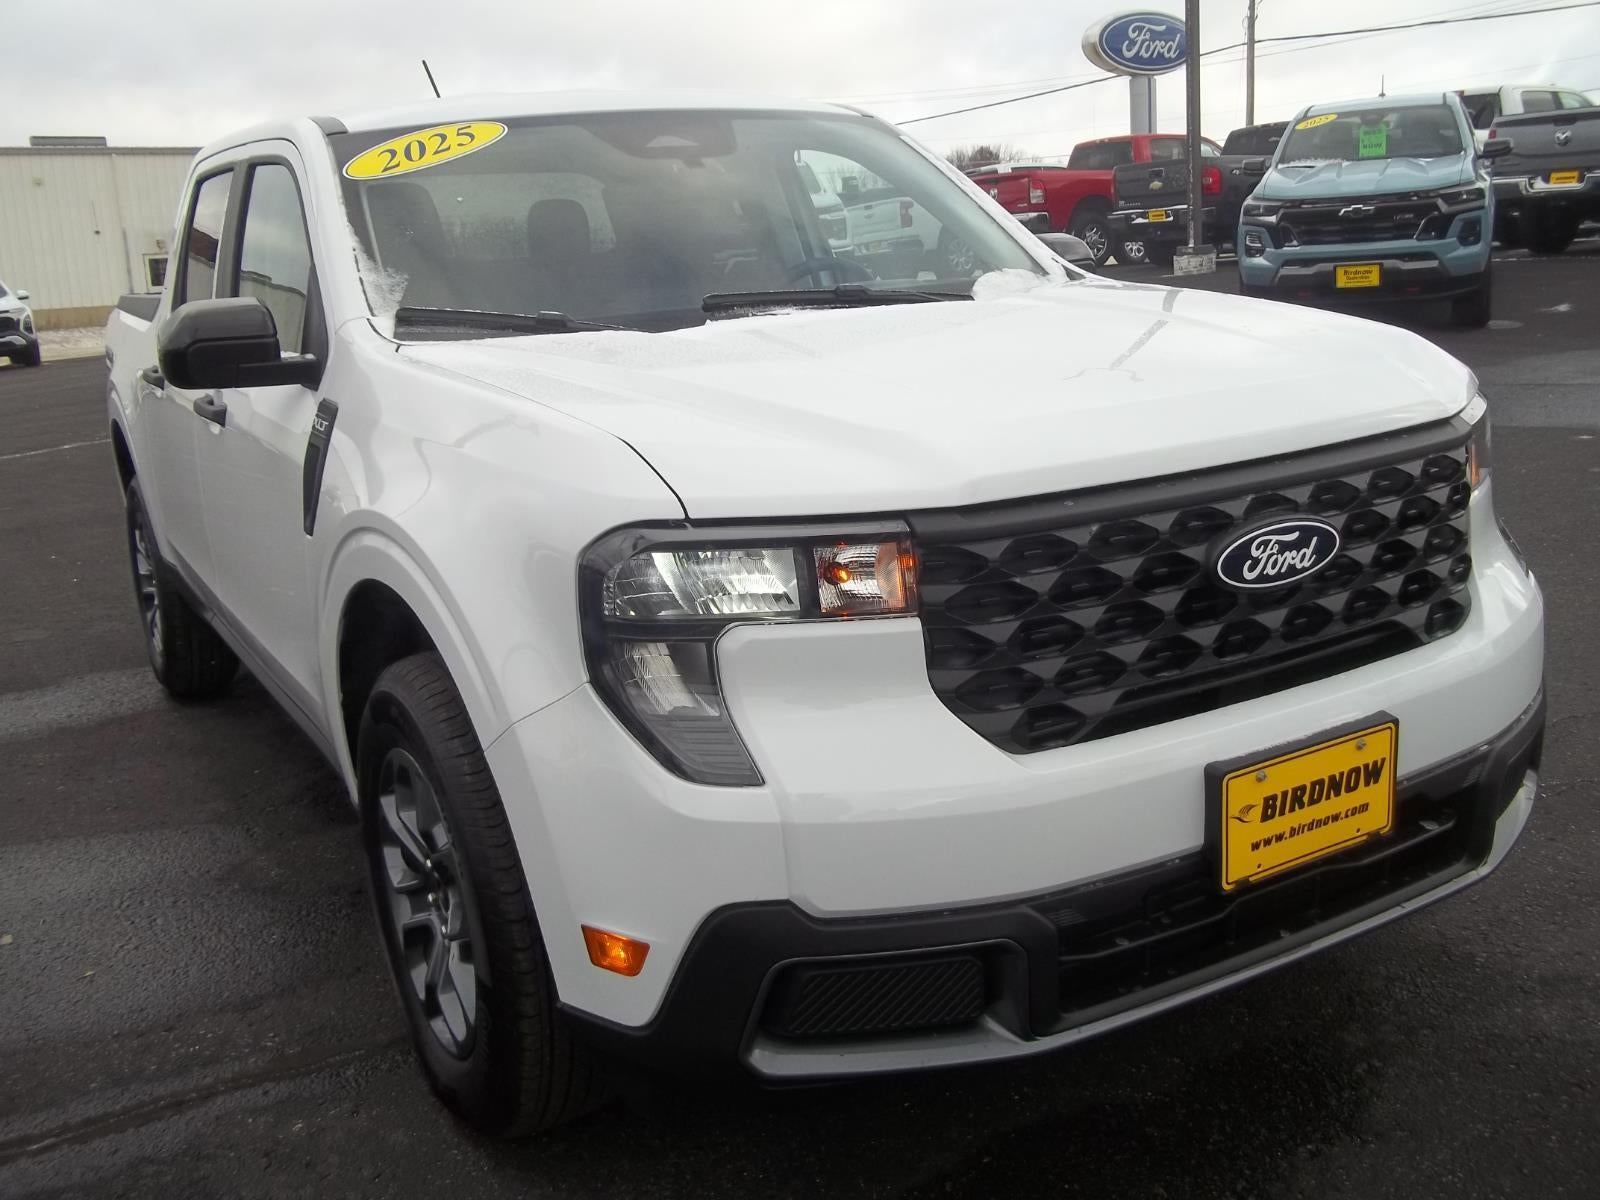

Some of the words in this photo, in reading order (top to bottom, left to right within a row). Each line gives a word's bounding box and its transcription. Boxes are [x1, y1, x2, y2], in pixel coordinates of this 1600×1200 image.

[1122, 22, 1180, 58] Ford
[377, 125, 476, 173] 2025
[1243, 531, 1318, 580] Ford
[1260, 757, 1386, 823] BIRDNOW
[1250, 802, 1369, 852] www.birdnow.com
